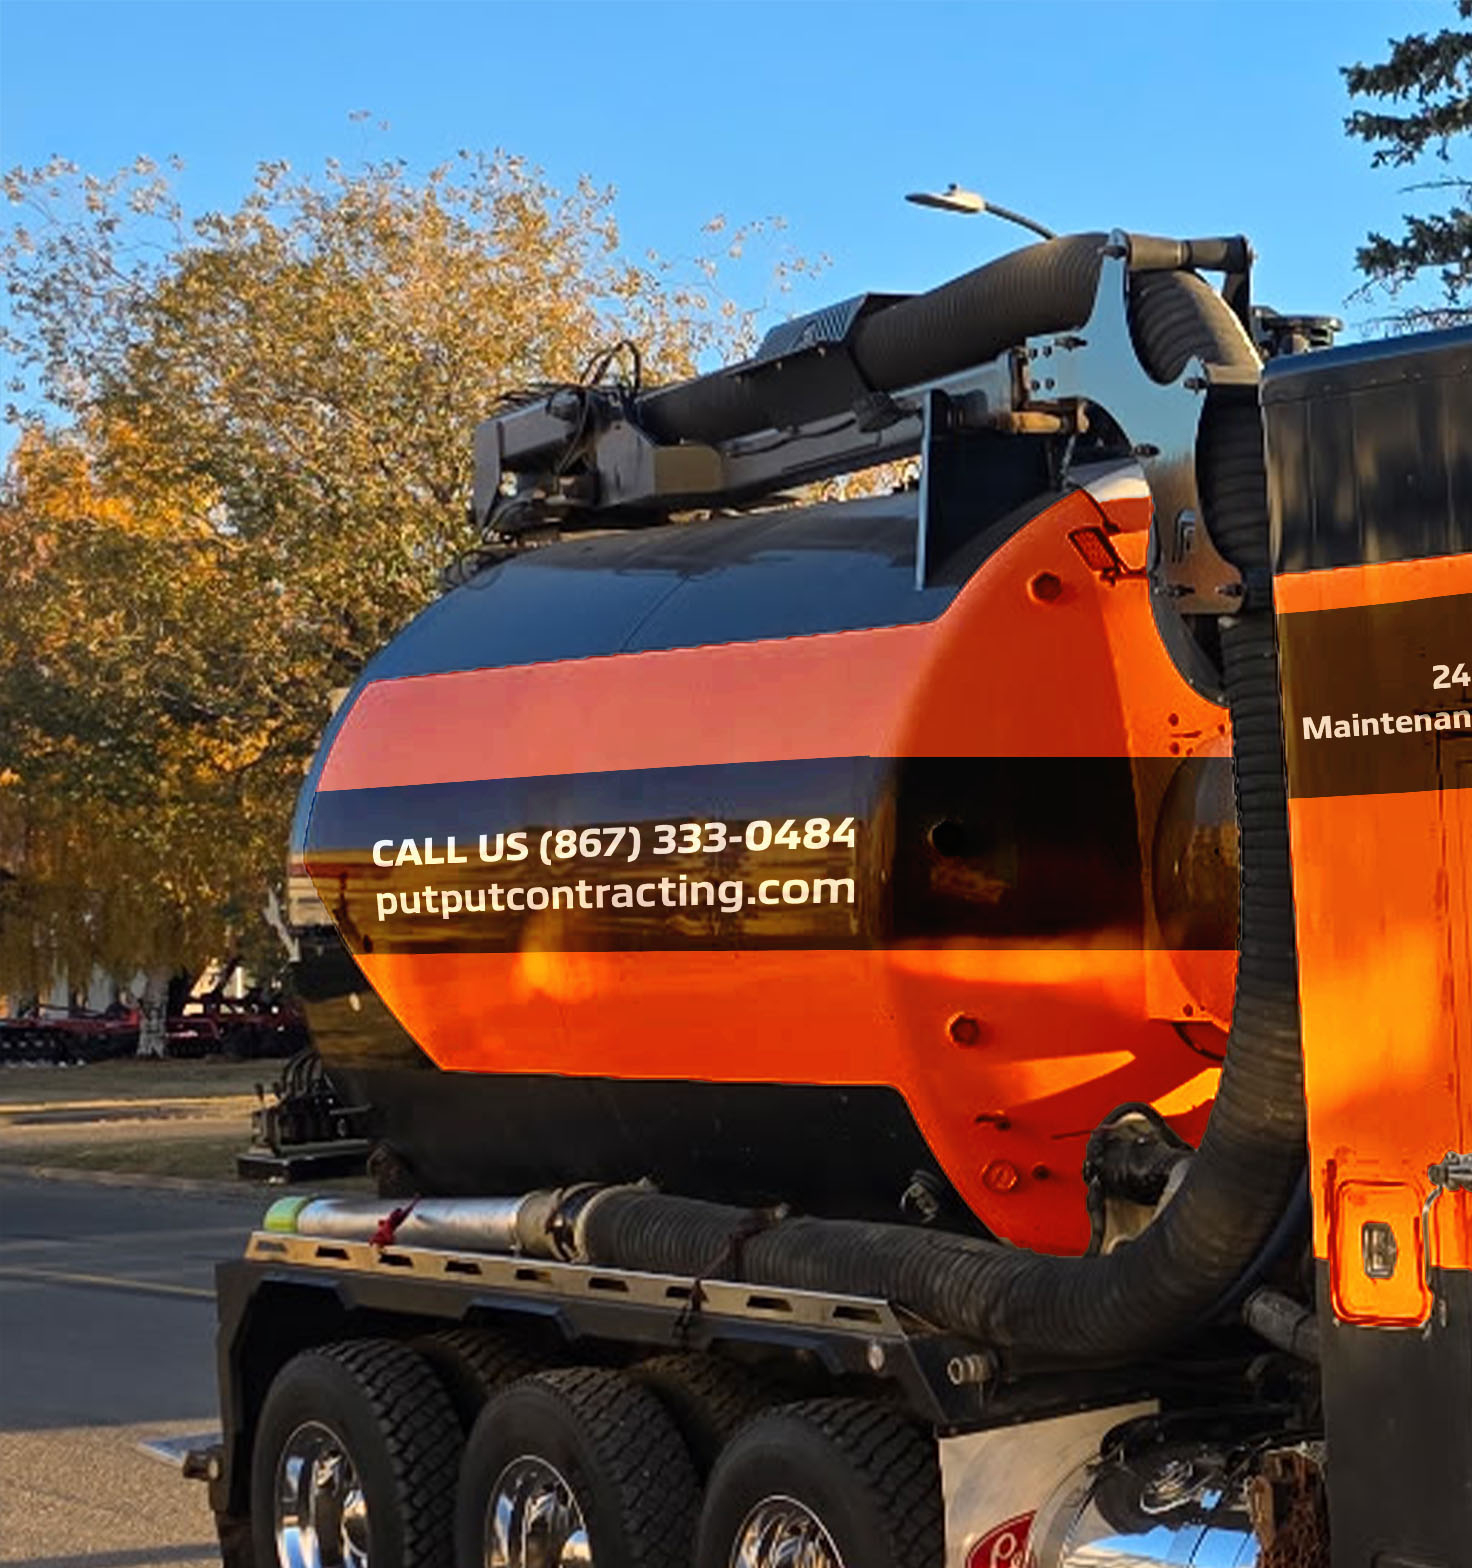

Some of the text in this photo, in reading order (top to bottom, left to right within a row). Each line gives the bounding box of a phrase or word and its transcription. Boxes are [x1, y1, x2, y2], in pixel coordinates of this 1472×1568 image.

[1432, 663, 1471, 690] 24
[372, 816, 856, 868] CALL US (867) 333-0484
[376, 873, 855, 922] putputcontracting.com
